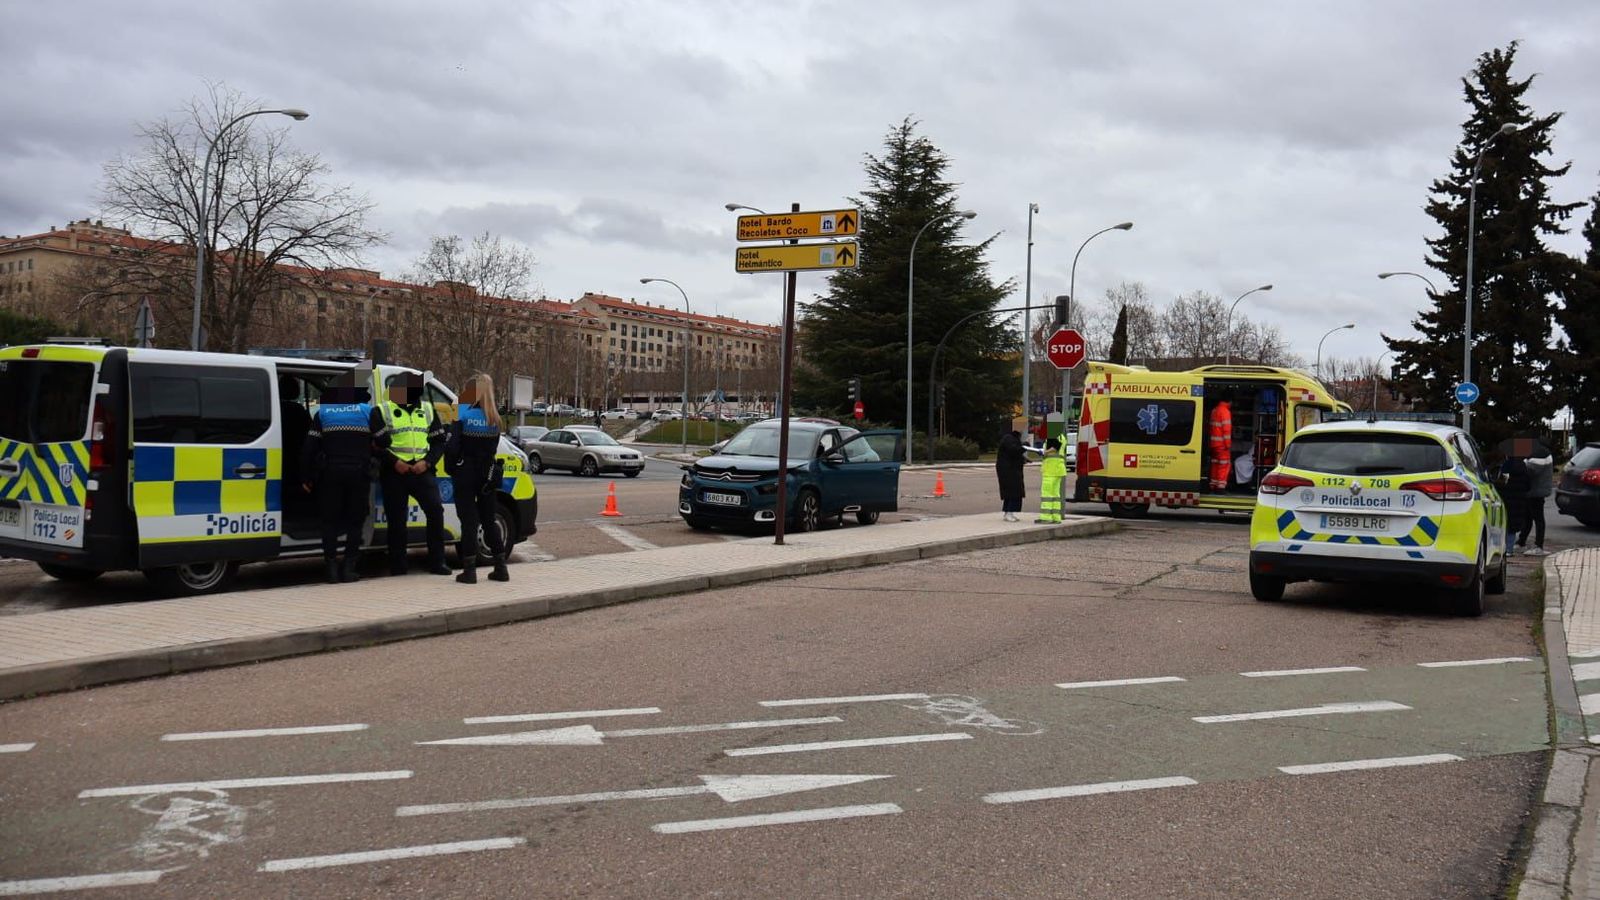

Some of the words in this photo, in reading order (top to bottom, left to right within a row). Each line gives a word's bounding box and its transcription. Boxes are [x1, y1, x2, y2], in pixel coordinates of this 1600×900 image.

[740, 219, 761, 227] hotel
[767, 217, 792, 226] Bardo
[740, 228, 781, 237] Recoletos
[786, 227, 808, 235] Coco
[739, 251, 759, 259] hotel
[1051, 344, 1081, 354] STOP
[1113, 384, 1189, 395] AMBULANCIA
[1327, 477, 1345, 486] 112
[1370, 478, 1390, 488] 708
[60, 512, 79, 525] Local
[219, 513, 276, 534] Policía
[1329, 516, 1359, 528] 5589
[1363, 518, 1386, 529] LRC
[37, 523, 57, 539] 112
